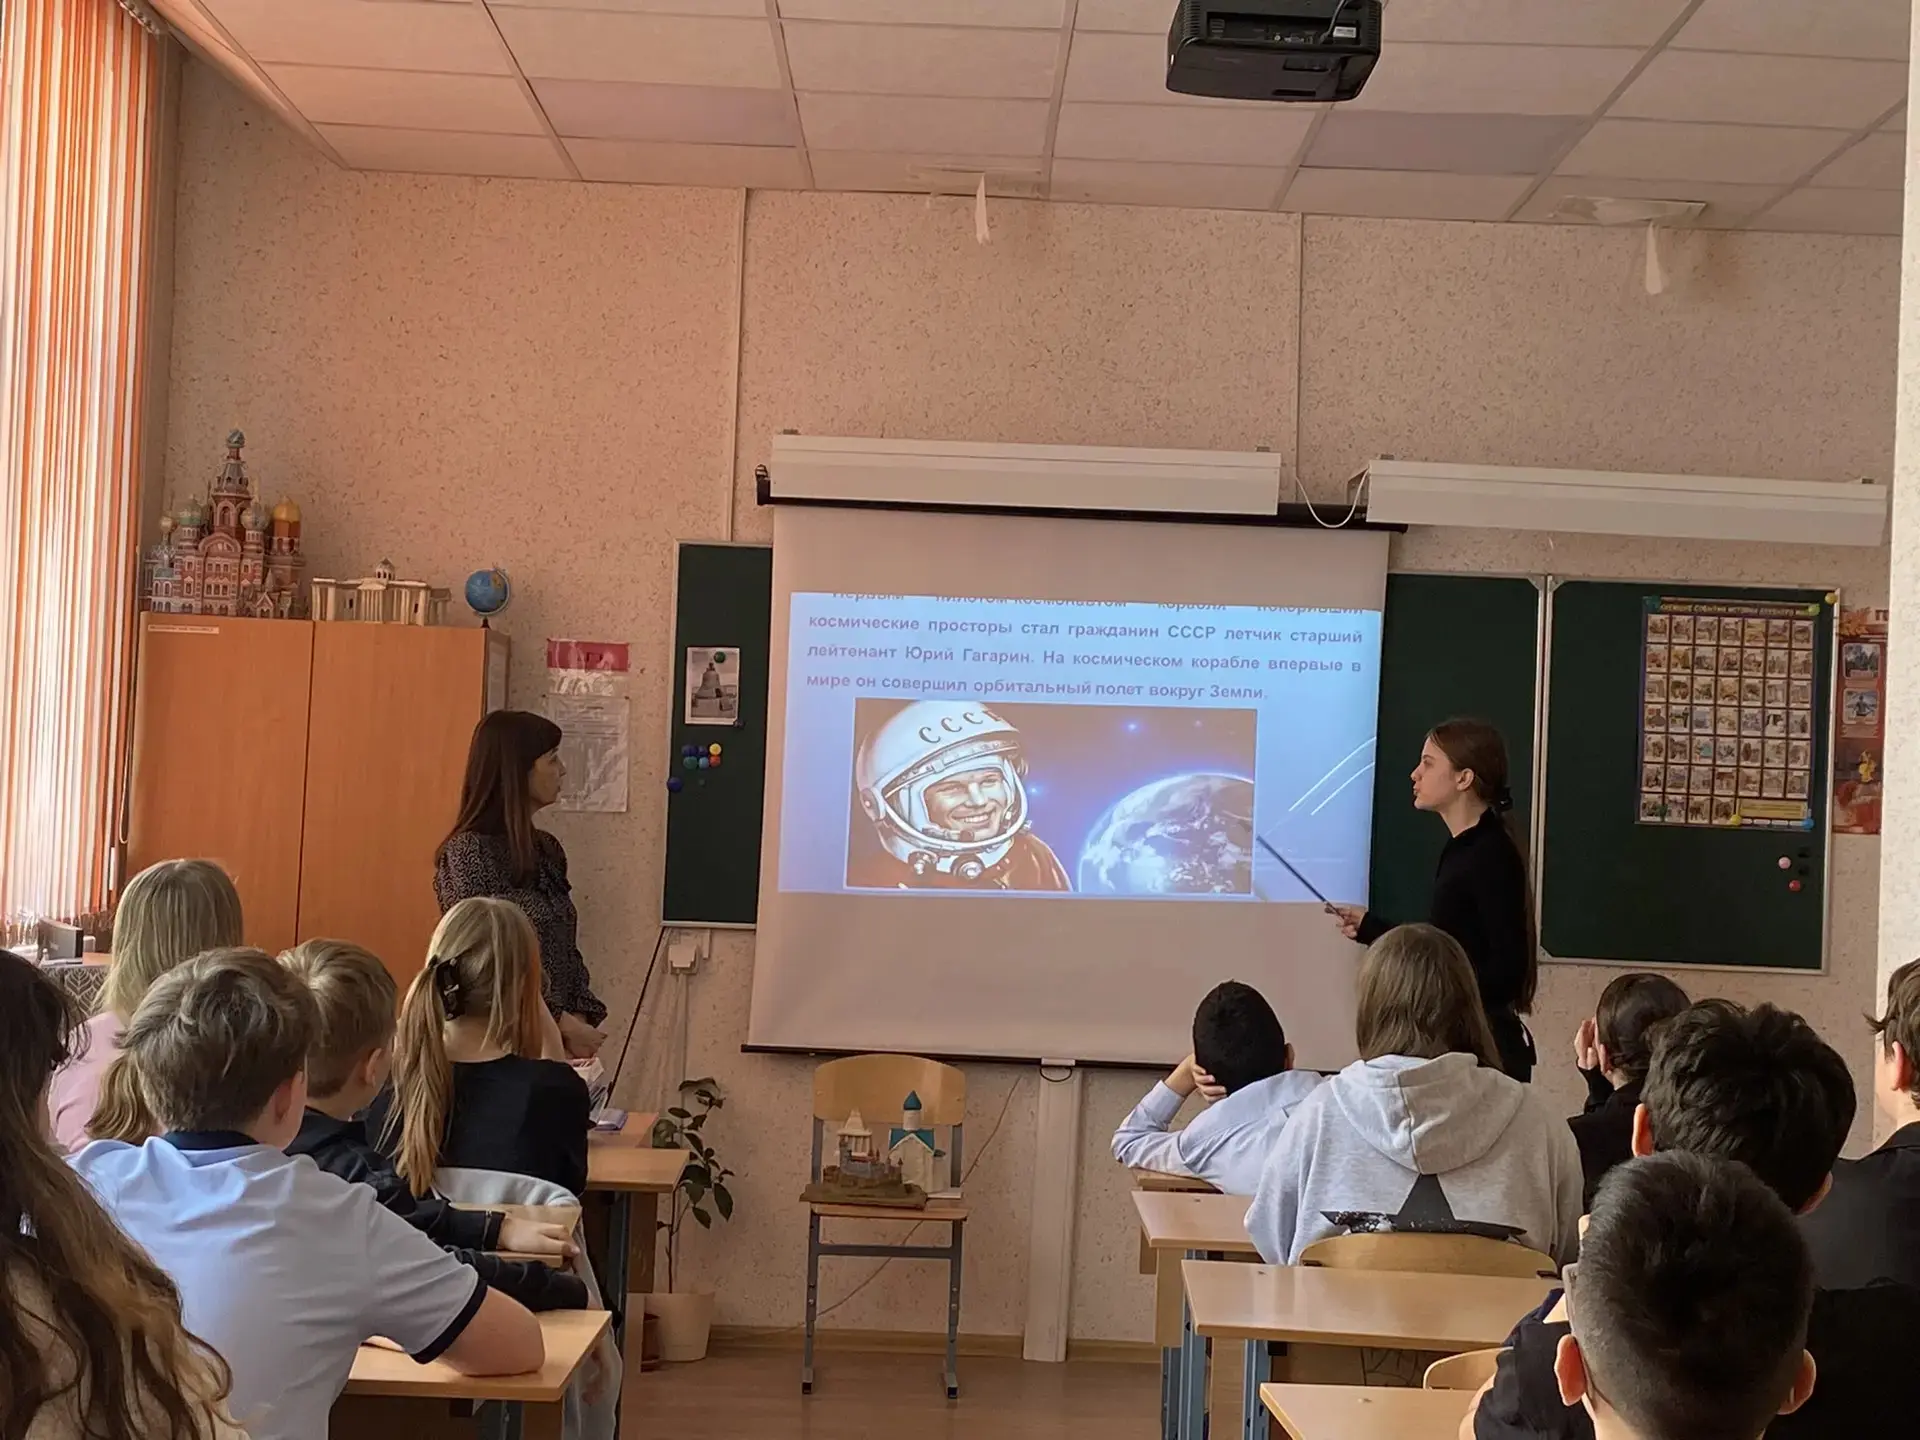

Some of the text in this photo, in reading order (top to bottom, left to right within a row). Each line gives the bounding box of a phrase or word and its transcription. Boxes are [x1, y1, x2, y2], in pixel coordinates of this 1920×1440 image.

[809, 616, 1362, 645] космические просторы стал гражданин СССР летчик старший
[807, 644, 1361, 673] лейтенант Юрий Гагарин. На космическом корабле впервые в
[806, 675, 1268, 700] мире он совершил орбитальный полет вокруг Земли.
